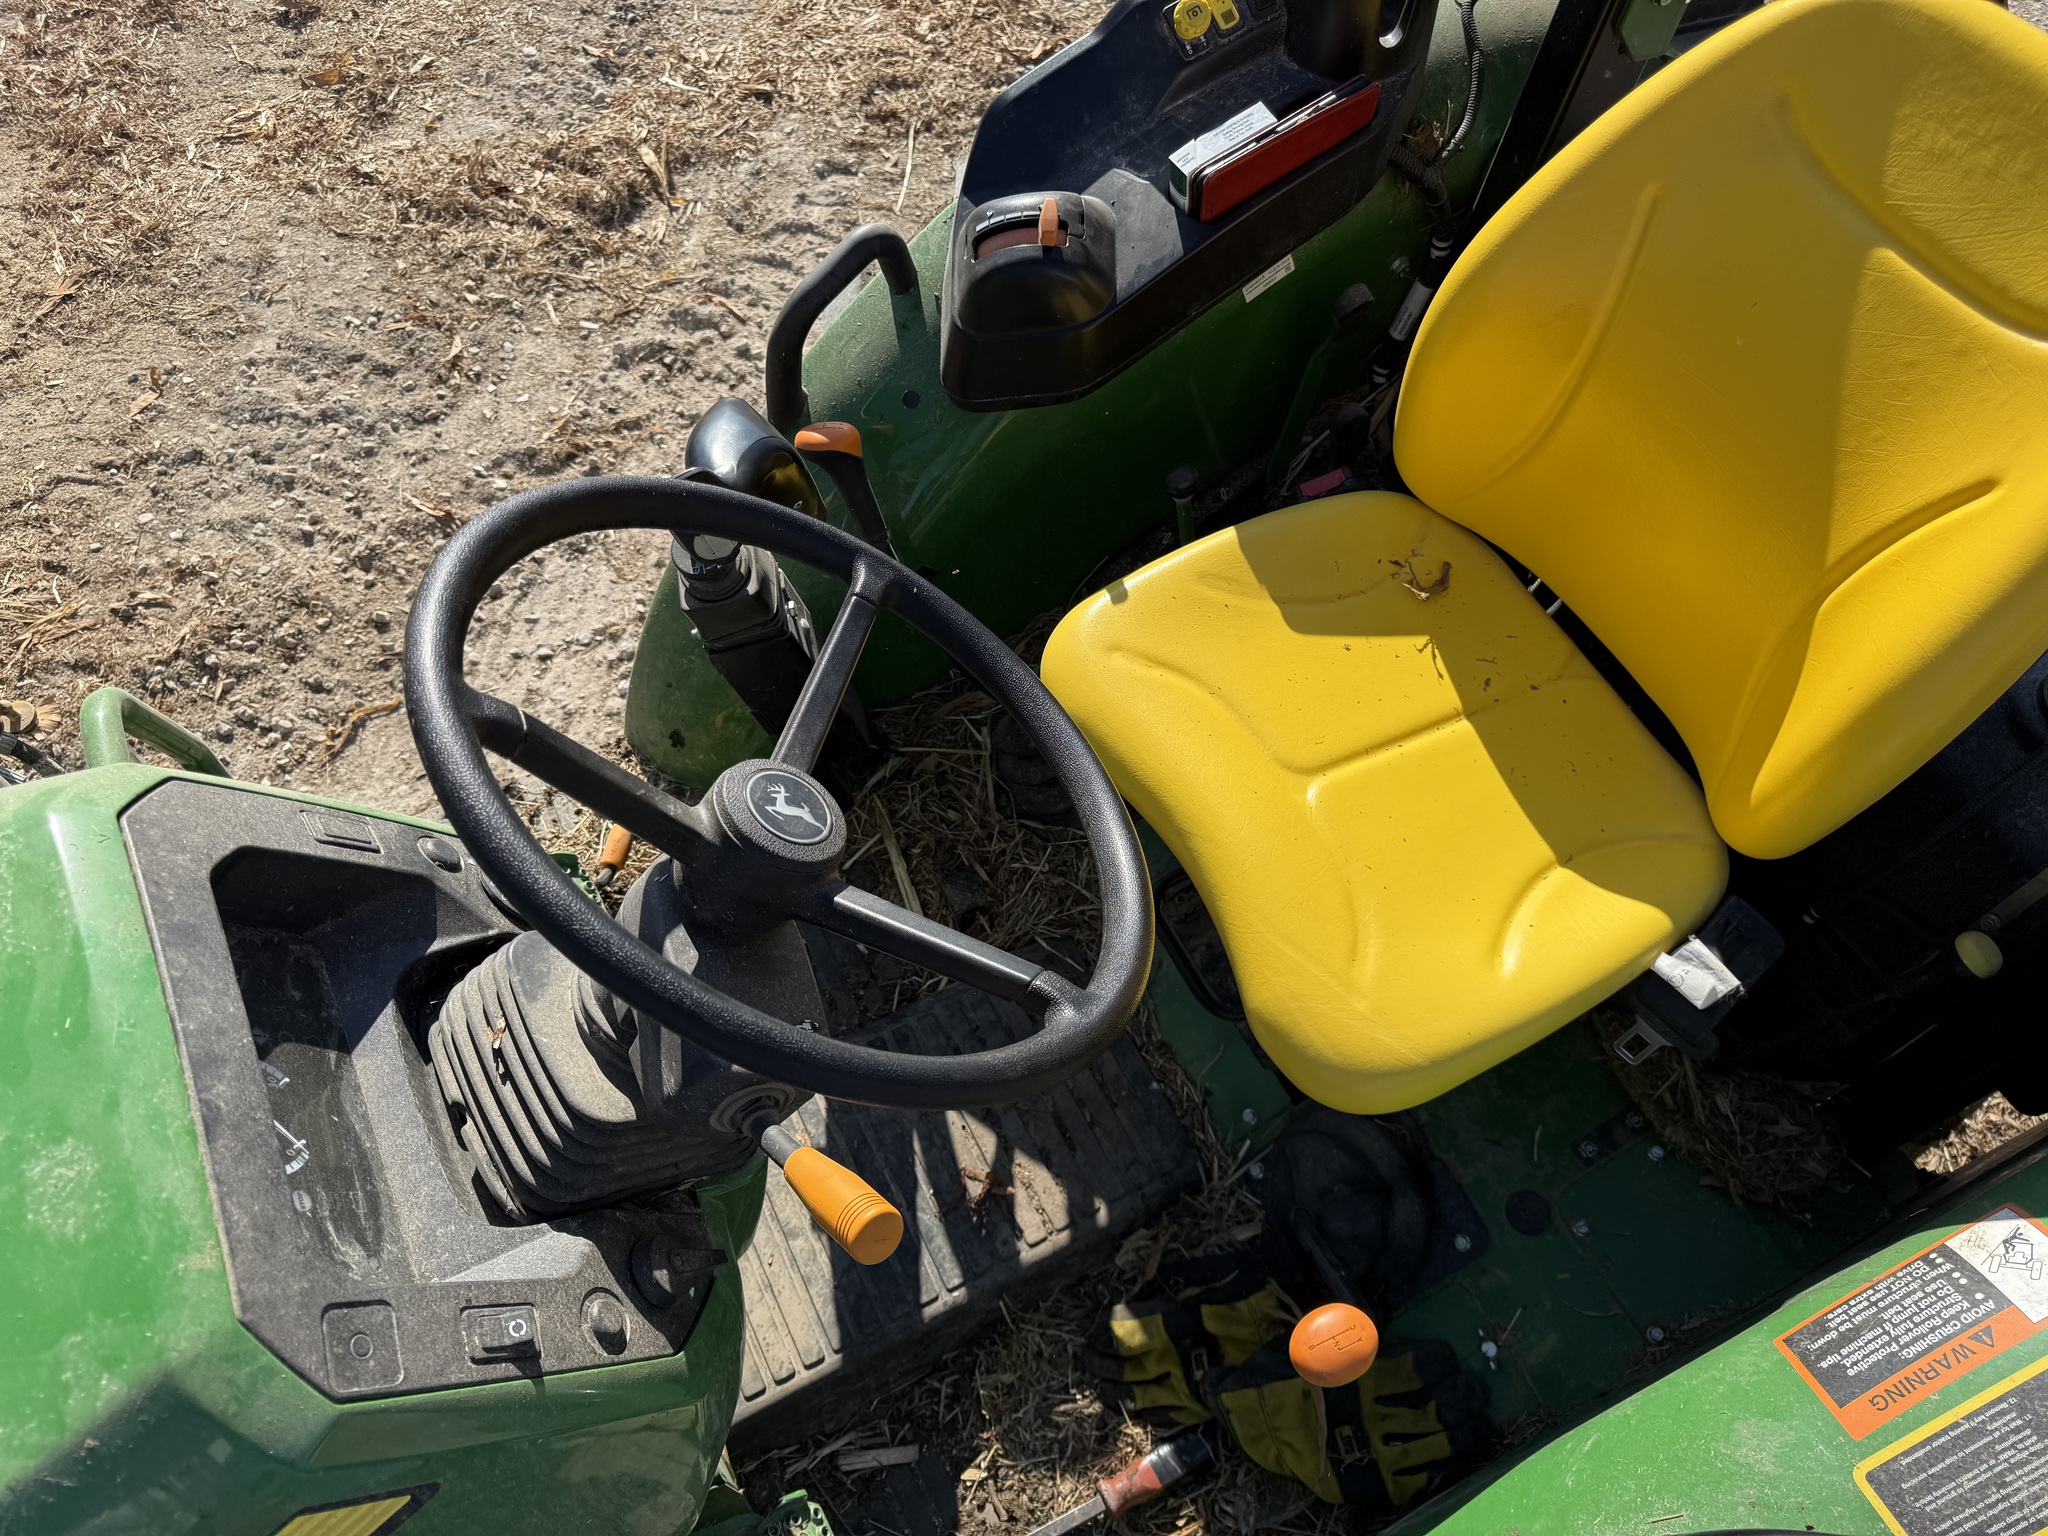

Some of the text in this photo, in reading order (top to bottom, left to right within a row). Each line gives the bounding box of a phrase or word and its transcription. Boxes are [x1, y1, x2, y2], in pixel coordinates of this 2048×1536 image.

[296, 1190, 308, 1211] STOP
[1920, 1261, 1954, 1282] When
[1822, 1260, 1923, 1321] Drive with extra care.
[1824, 1264, 1930, 1329] DO NOT use seat belt.
[1876, 1278, 1924, 1308] structure
[1877, 1278, 1947, 1321] Use seat belt.
[1850, 1305, 1879, 1324] must
[1815, 1284, 1954, 1370] Do not jump if machine tips.
[1837, 1321, 1853, 1333] be
[1838, 1291, 1963, 1368] Structure fully extended.
[1896, 1298, 1997, 1360] AVOID CRUSHING:
[1844, 1298, 1970, 1377] Keep Rollover Protective
[1866, 1341, 1977, 1413] WARNING
[2006, 1394, 2016, 1406] 12.
[1974, 1411, 1984, 1424] key
[1985, 1400, 2006, 1419] Remove
[1948, 1420, 1969, 1439] leaving
[1985, 1410, 2016, 1433] machinery.
[2000, 1424, 2009, 1433] for
[2008, 1417, 2022, 1429] Wait
[1931, 1433, 1948, 1449] tractor
[1992, 1430, 2000, 1438] all
[1993, 1426, 2031, 1452] dismounting.
[1963, 1434, 1993, 1454] movement
[2029, 1440, 2042, 1455] Stop
[1900, 1444, 1931, 1468] unattended.
[1944, 1454, 1957, 1465] stop
[1956, 1450, 1964, 1458] to
[1914, 1434, 2037, 1508] shift to "PARK" or set brake(s) securely before
[1926, 1461, 1945, 1476] before
[1992, 1461, 2008, 1474] lower
[2015, 1467, 2022, 1477] by
[1901, 1470, 1927, 1490] servicing
[1962, 1469, 1992, 1490] implement
[1999, 1478, 2023, 1496] warning
[2028, 1480, 2044, 1494] brake
[1935, 1489, 1957, 1505] ground
[1975, 1501, 1984, 1509] on
[1983, 1491, 2000, 1505] lights
[2008, 1488, 2028, 1505] pedals
[1924, 1502, 1937, 1512] and
[1951, 1505, 1976, 1522] highway
[1984, 1498, 2010, 1518] together
[1962, 1519, 1978, 1530] road
[1976, 1514, 1986, 1523] for
[2005, 1510, 2022, 1524] steep
[2028, 1515, 2035, 1523] or
[1932, 1519, 1954, 1533] unless
[1983, 1519, 2006, 1536] slopes.
